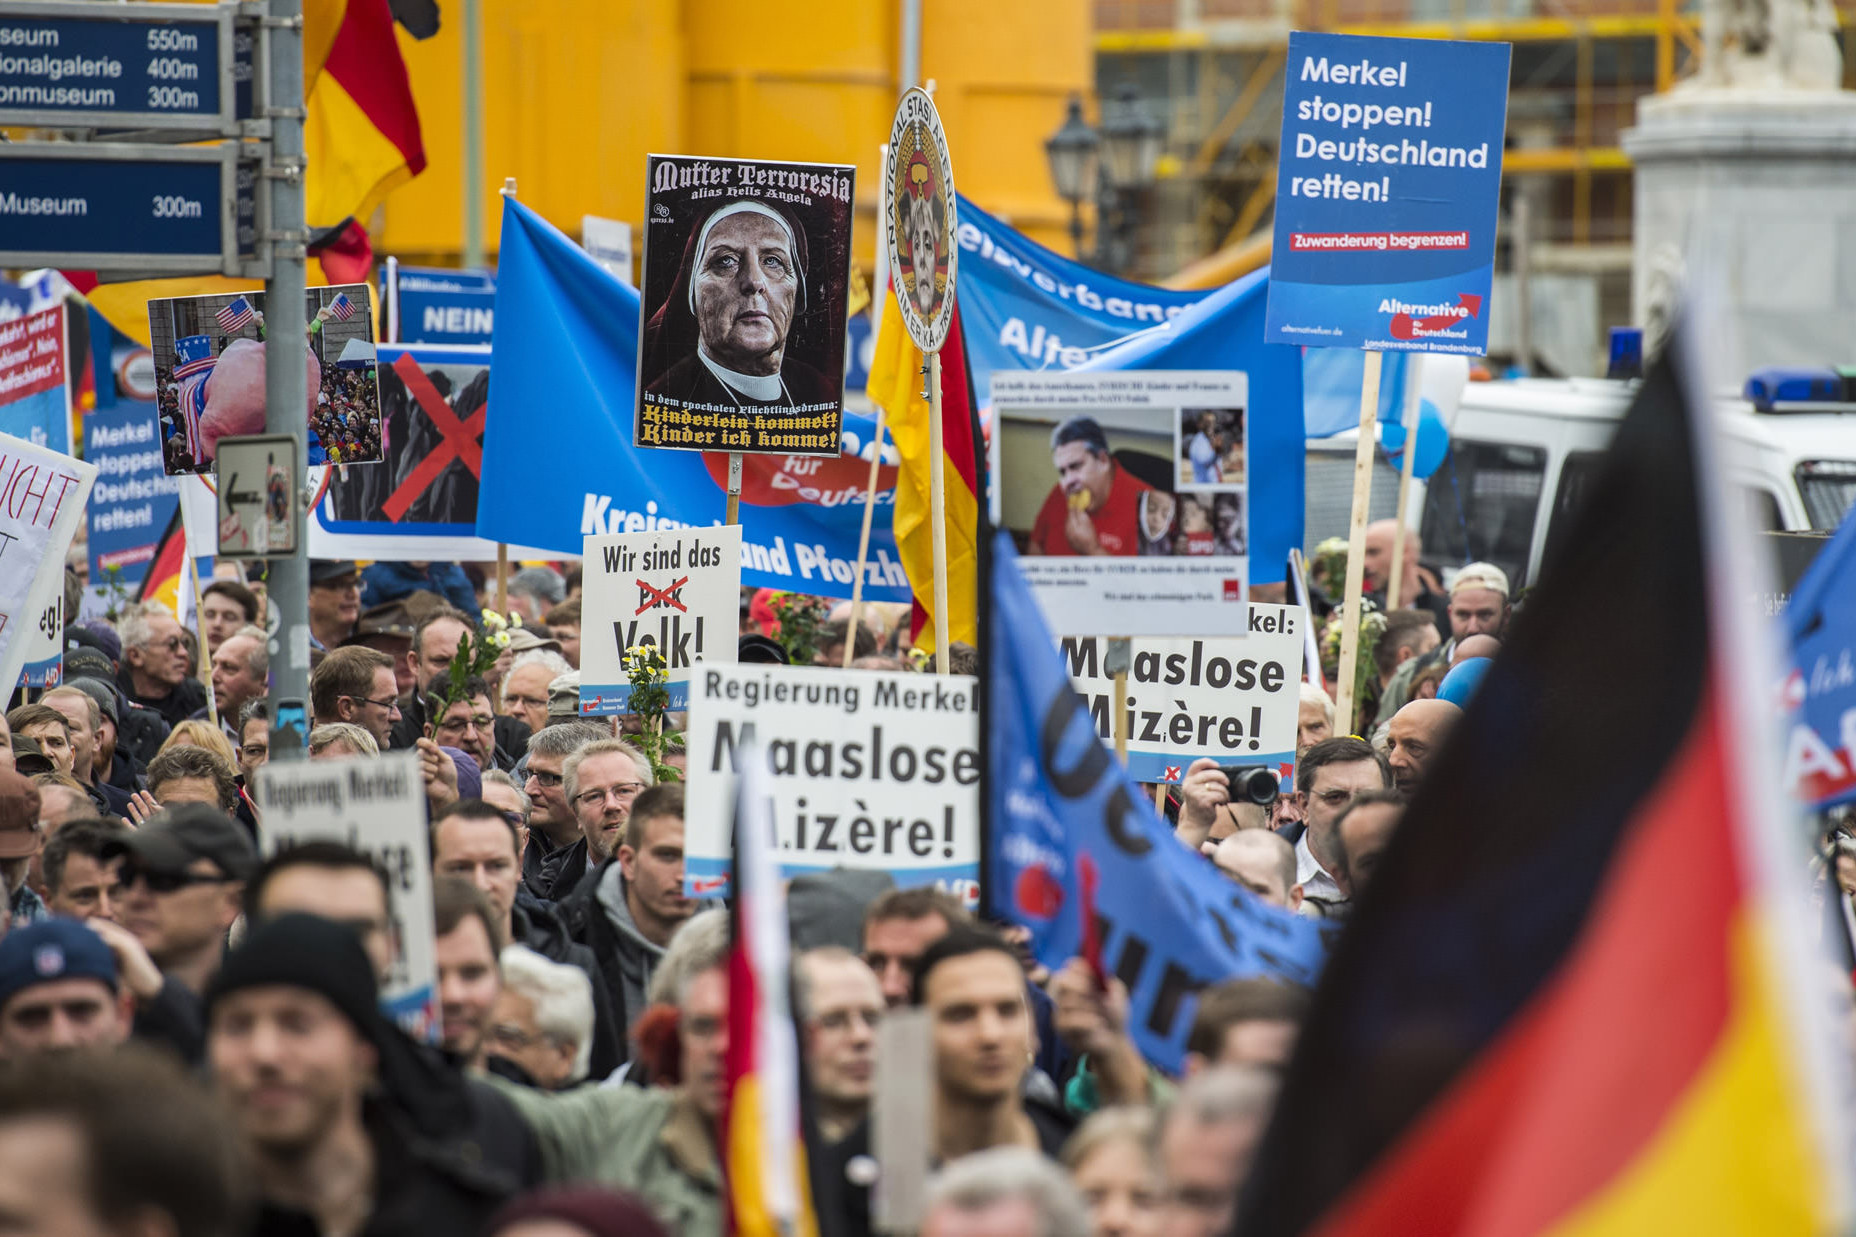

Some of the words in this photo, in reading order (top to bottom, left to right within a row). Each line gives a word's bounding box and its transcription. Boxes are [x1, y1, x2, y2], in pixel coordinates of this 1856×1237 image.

[0, 28, 59, 47] seum
[147, 29, 198, 51] 550m
[147, 58, 198, 80] 400m
[1301, 57, 1407, 87] Merkel
[0, 85, 115, 106] onmuseum
[148, 87, 198, 109] 300m
[1298, 96, 1432, 129] stoppen!
[1296, 133, 1488, 168] Deutschland
[652, 161, 732, 194] Mutter
[738, 165, 850, 203] Terroresia
[888, 112, 907, 245] NATIONAL
[907, 97, 932, 126] STASI
[933, 125, 955, 241] AGENCY
[691, 188, 722, 200] alias
[764, 188, 812, 206] Angela
[1291, 174, 1390, 202] retten!
[0, 193, 87, 215] Museum
[152, 196, 201, 217] 300m
[1295, 234, 1387, 249] Zuwanderung
[1389, 232, 1467, 248] begrenzen!
[423, 306, 493, 333] NEIN
[1378, 299, 1469, 317] Alternative
[1000, 317, 1103, 370] Alte
[1365, 340, 1428, 350] Landesverband
[1429, 343, 1482, 354] Brandenburg
[1412, 328, 1467, 339] Deutschland
[644, 391, 655, 401] in
[658, 394, 679, 406] dem
[682, 400, 735, 414] epochalen
[643, 404, 748, 429] Kinderlein
[755, 412, 838, 429] kommet!
[92, 419, 153, 448] Merkel
[641, 423, 716, 445] Kinder
[721, 430, 751, 447] ich
[758, 431, 838, 448] komme!
[783, 457, 823, 475] für
[0, 455, 80, 529] ICHT
[771, 472, 898, 507] Deutsc
[95, 503, 153, 532] retten!
[603, 545, 636, 573] Wir
[643, 540, 681, 571] sind
[688, 539, 721, 568] das
[1249, 607, 1295, 635] kel:
[706, 671, 859, 713] Regierung
